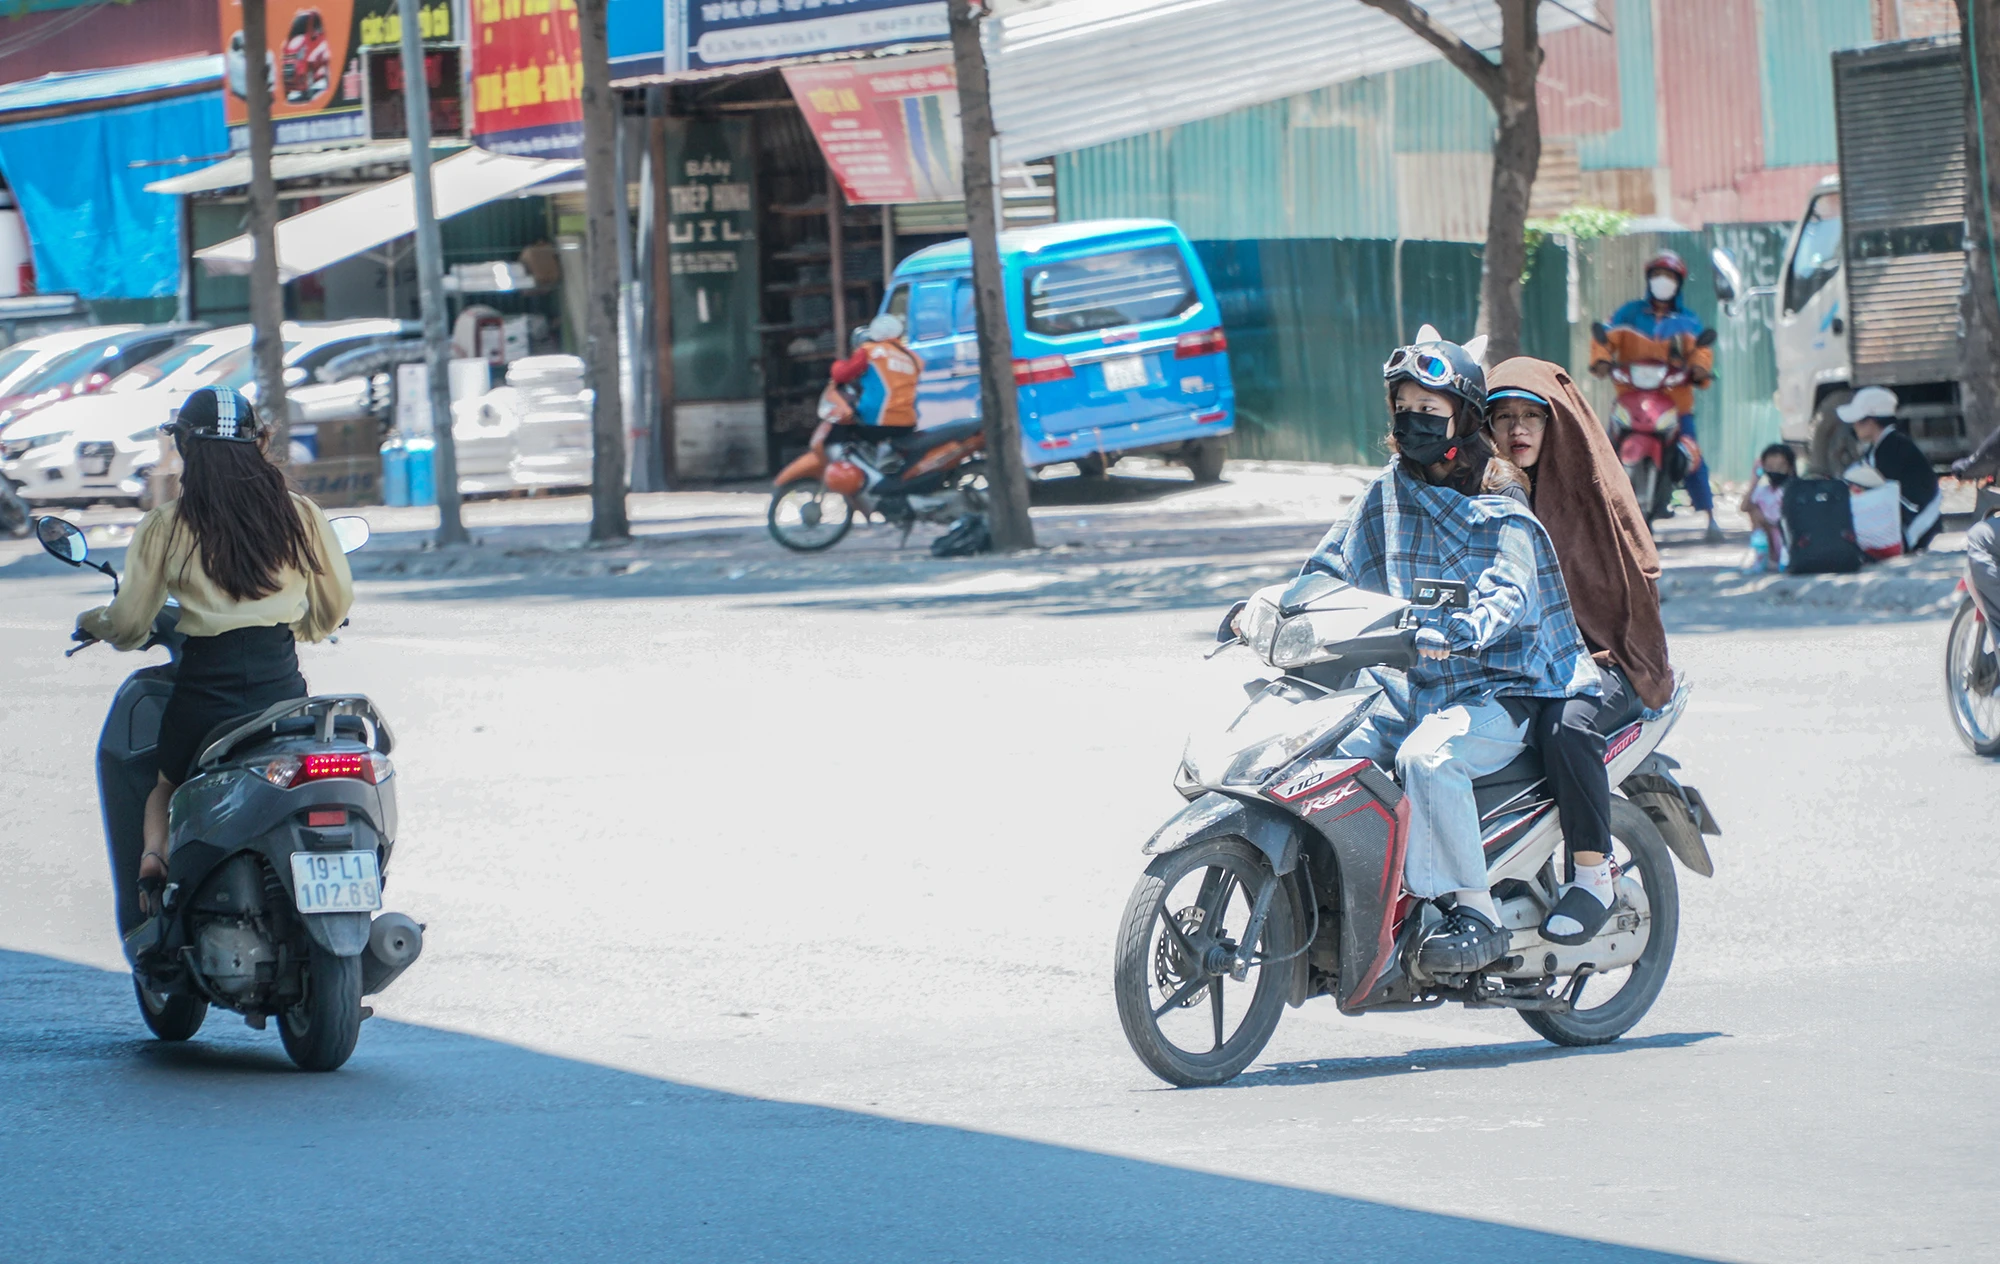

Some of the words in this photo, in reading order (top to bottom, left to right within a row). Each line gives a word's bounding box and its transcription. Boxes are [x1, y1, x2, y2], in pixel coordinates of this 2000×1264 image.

[1287, 772, 1324, 796] 110
[306, 856, 364, 880] 19-L1
[302, 882, 377, 907] 102.69
